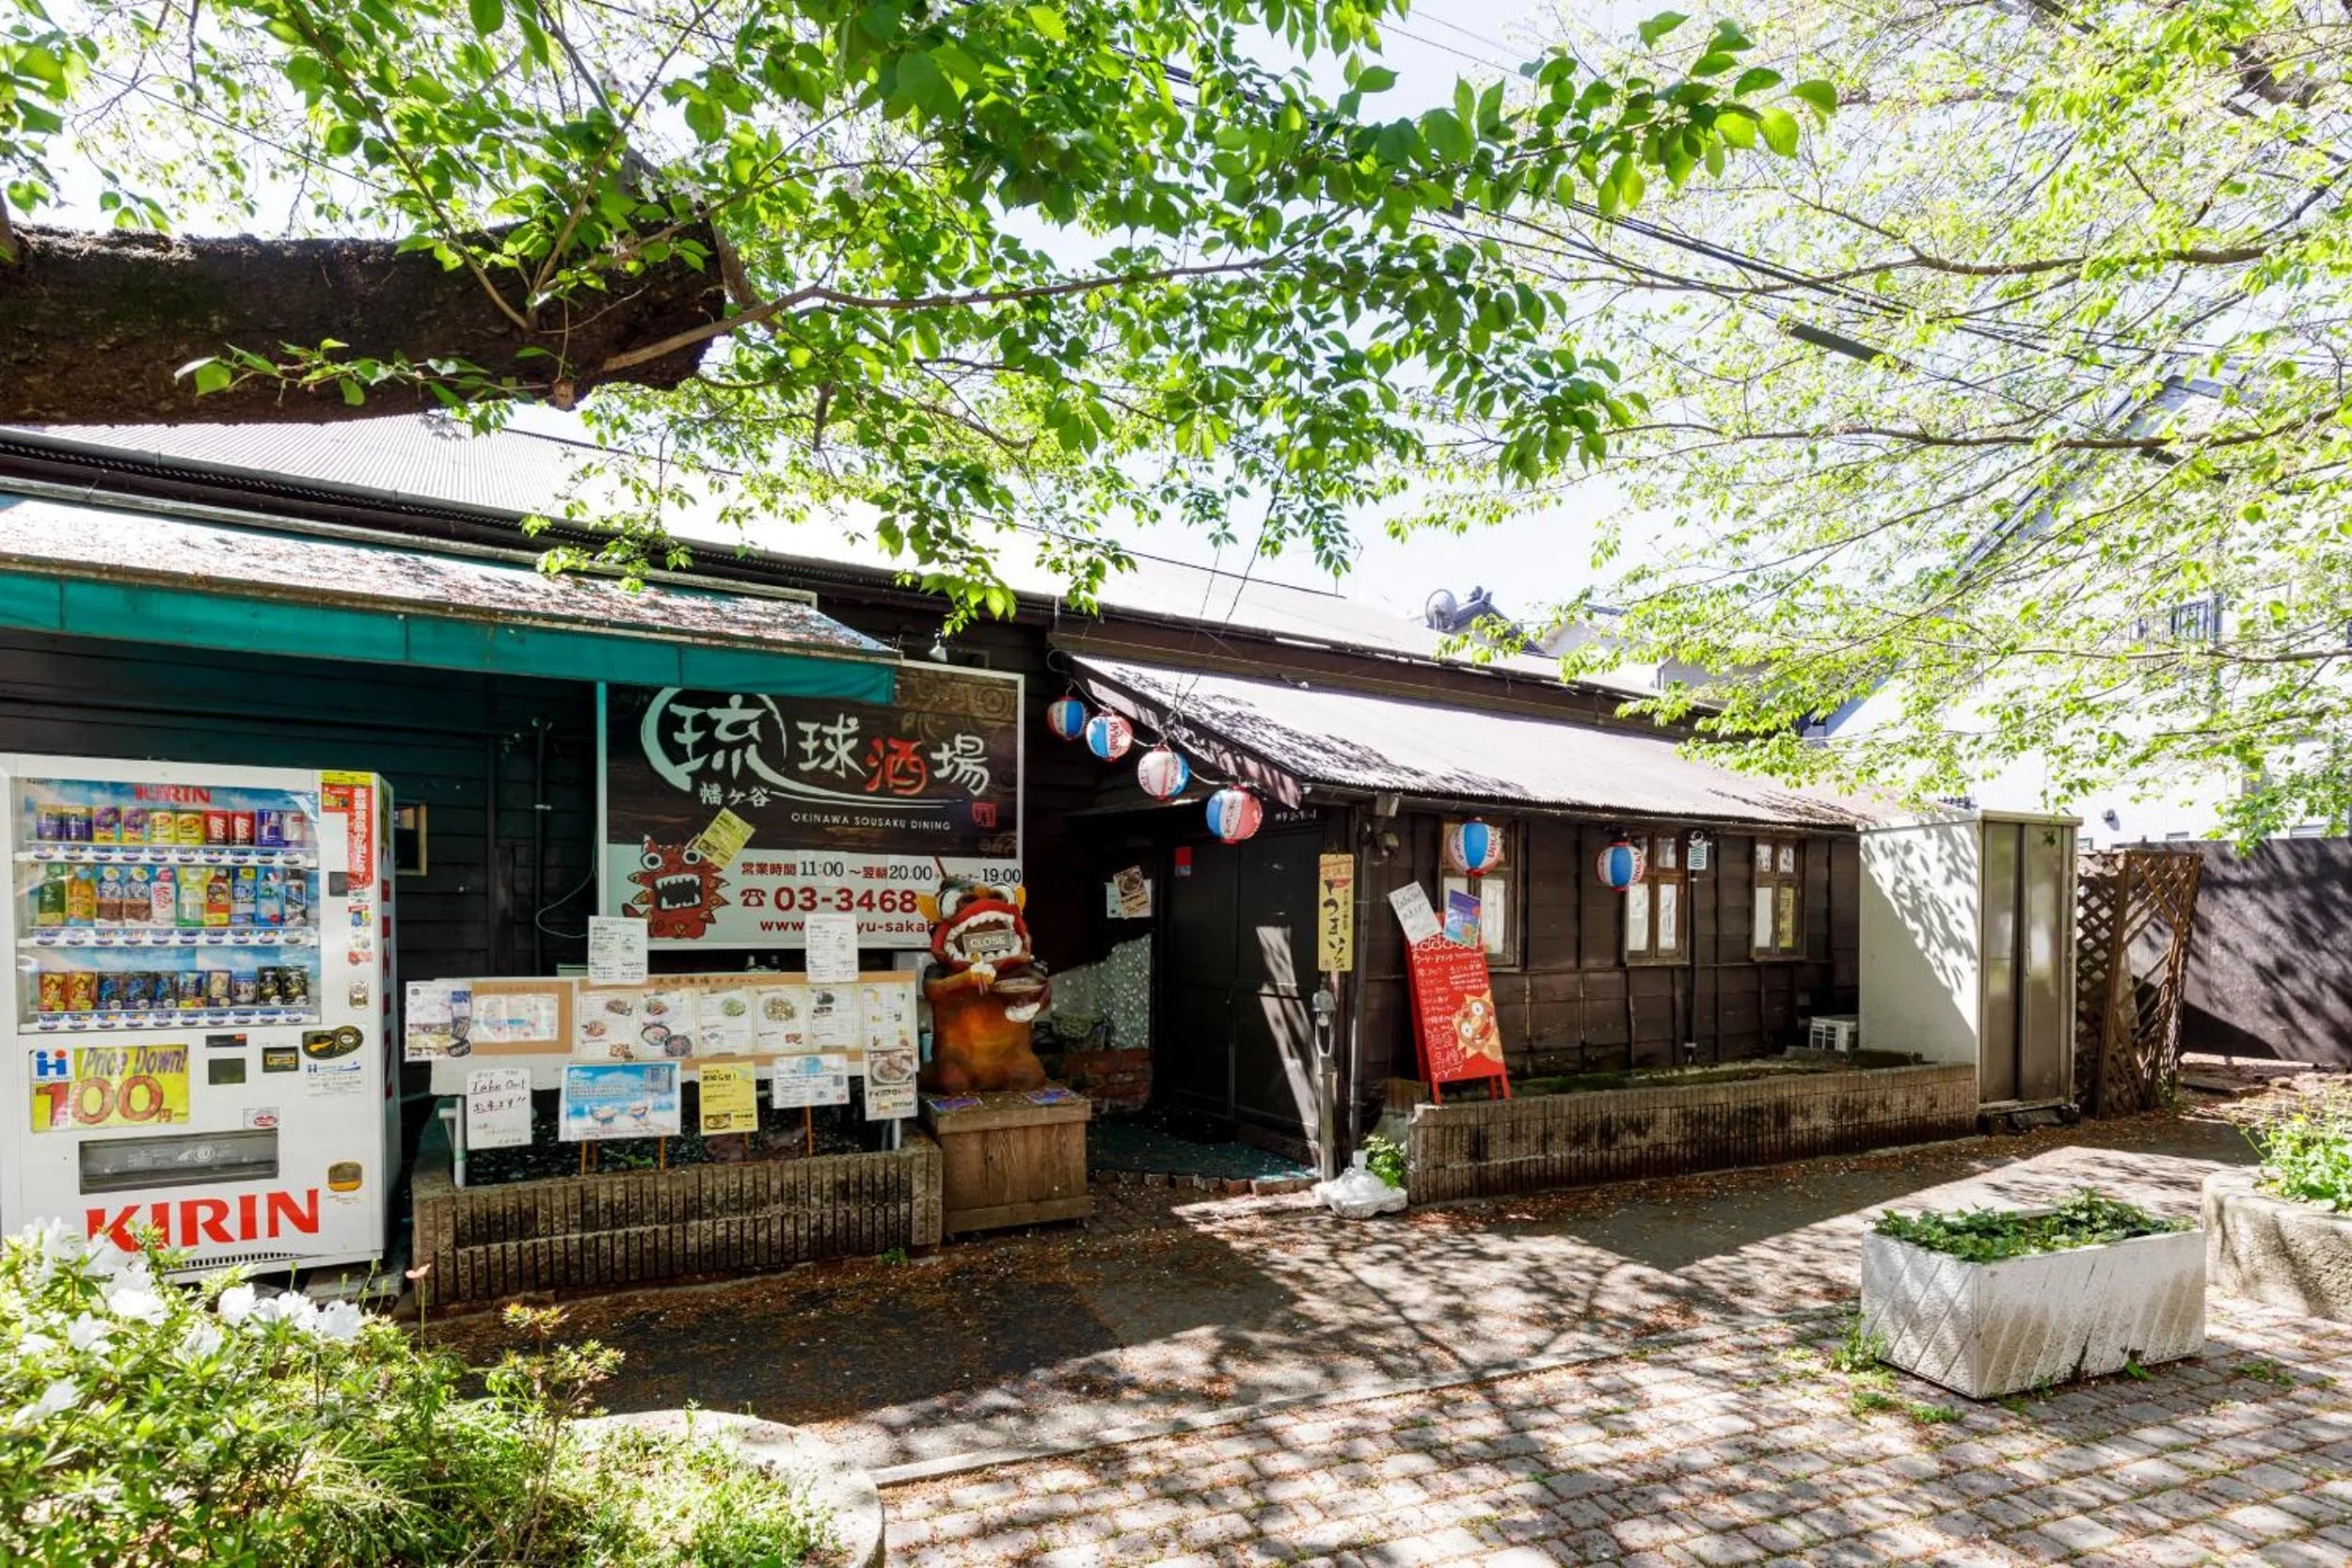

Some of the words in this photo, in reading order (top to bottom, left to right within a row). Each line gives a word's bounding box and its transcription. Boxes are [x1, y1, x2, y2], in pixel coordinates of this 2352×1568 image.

[669, 694, 991, 797] 琉球酒場
[135, 784, 212, 803] KIRIN
[791, 812, 850, 826] OKINAWA
[854, 815, 907, 830] SOUSAKU
[910, 818, 951, 832] DINING
[740, 862, 797, 876] 営業時間
[800, 861, 845, 878] 11:00
[982, 867, 1022, 883] 19:00
[773, 886, 918, 914] 03-3468
[969, 935, 1007, 947] CLOSE
[86, 1188, 320, 1253] KIRIN
